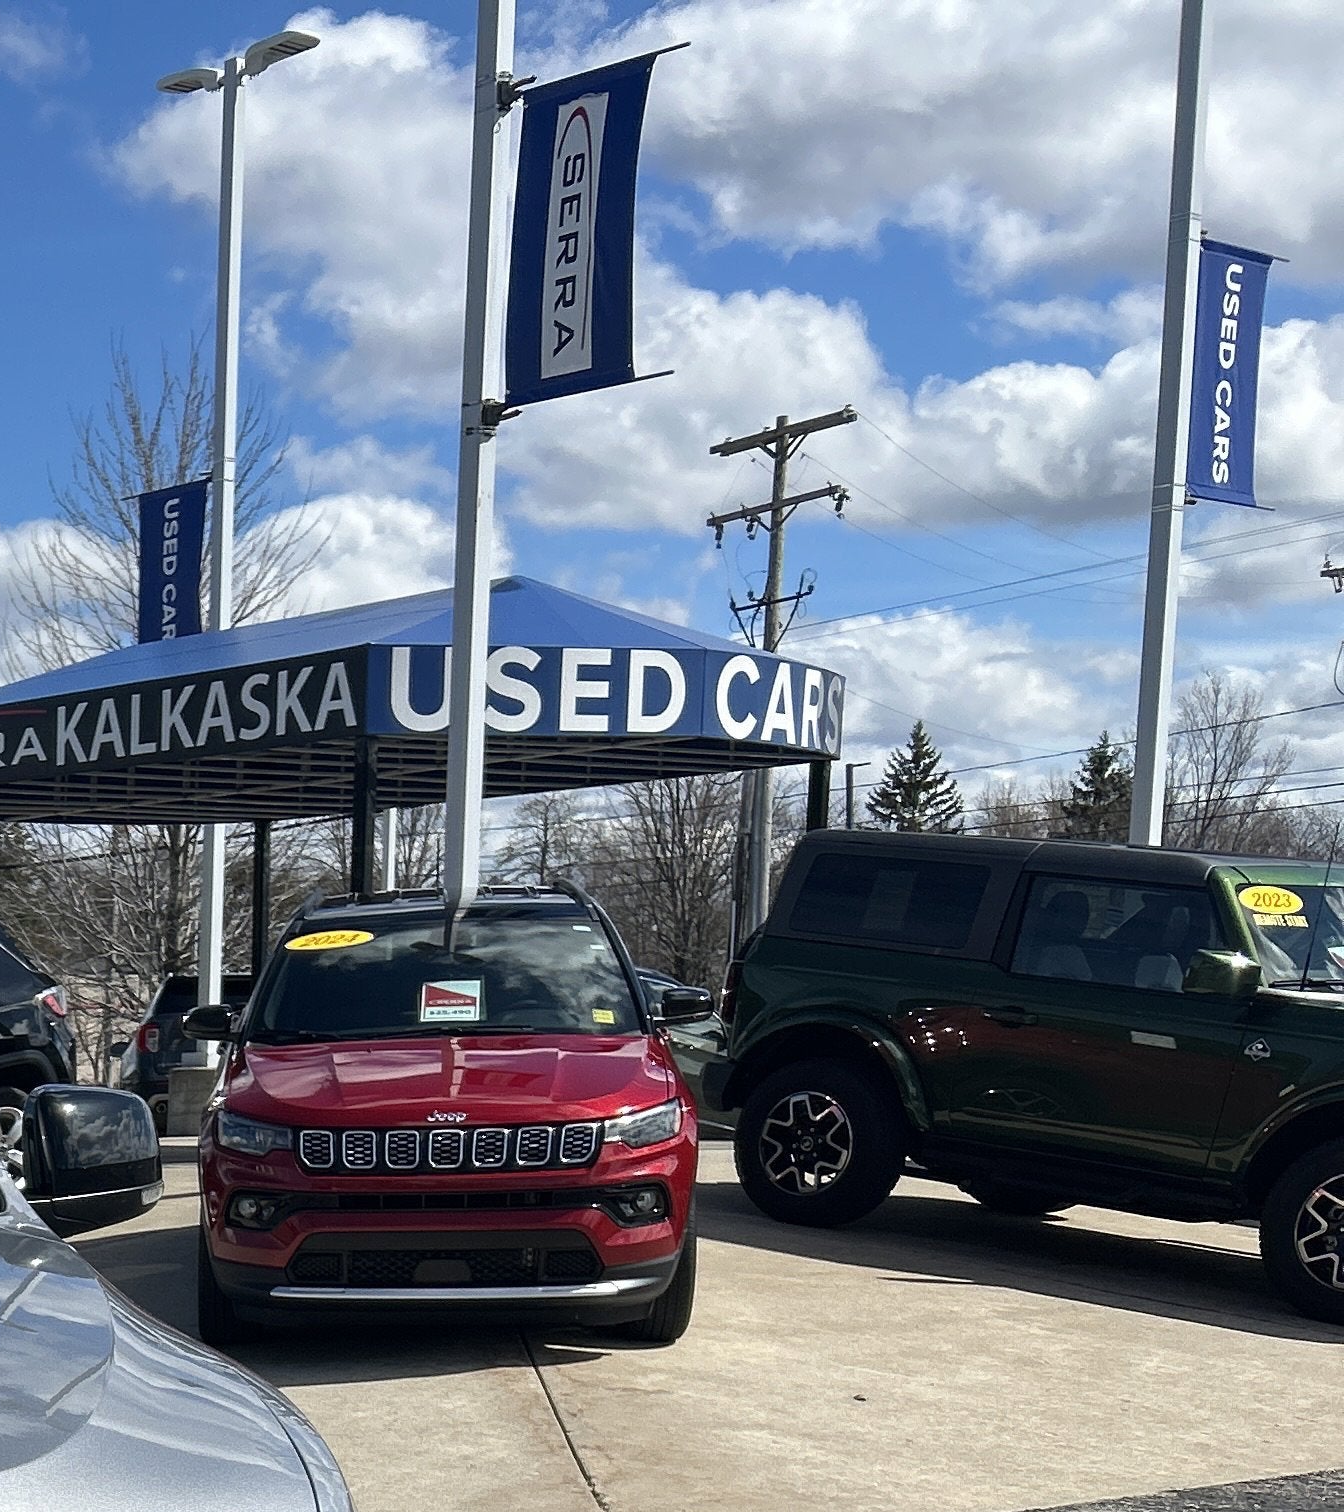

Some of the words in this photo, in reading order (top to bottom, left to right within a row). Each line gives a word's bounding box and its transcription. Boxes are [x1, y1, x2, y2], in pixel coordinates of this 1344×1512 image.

[552, 152, 585, 358] SERRA
[1218, 262, 1244, 370] USED
[1211, 379, 1233, 486] CARS
[162, 497, 180, 577] USED
[161, 583, 178, 640] CAR
[55, 661, 358, 767] KALKASKA
[389, 645, 687, 734] USED
[715, 653, 844, 756] CARS
[297, 933, 361, 948] 2024
[1251, 891, 1293, 909] 2023
[426, 1109, 468, 1123] Jeep
